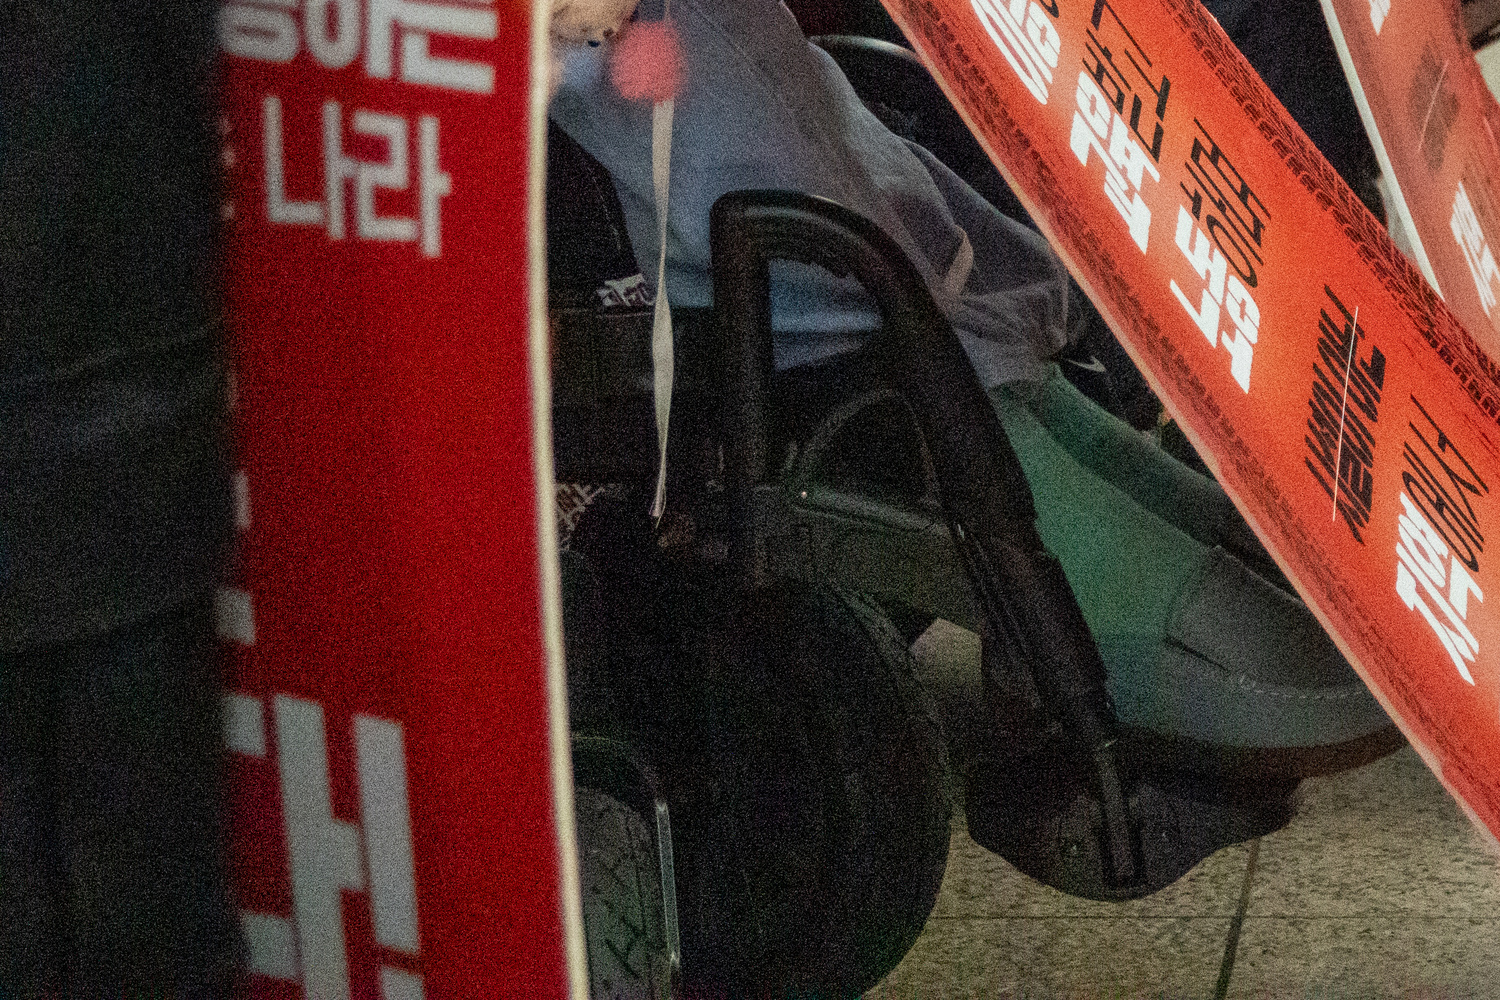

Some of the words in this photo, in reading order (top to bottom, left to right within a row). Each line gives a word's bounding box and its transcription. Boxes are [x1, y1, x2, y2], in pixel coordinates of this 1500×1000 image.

[262, 94, 452, 259] 나라
[1170, 118, 1272, 395] 노동하며
[1394, 395, 1492, 686] 지역에서
